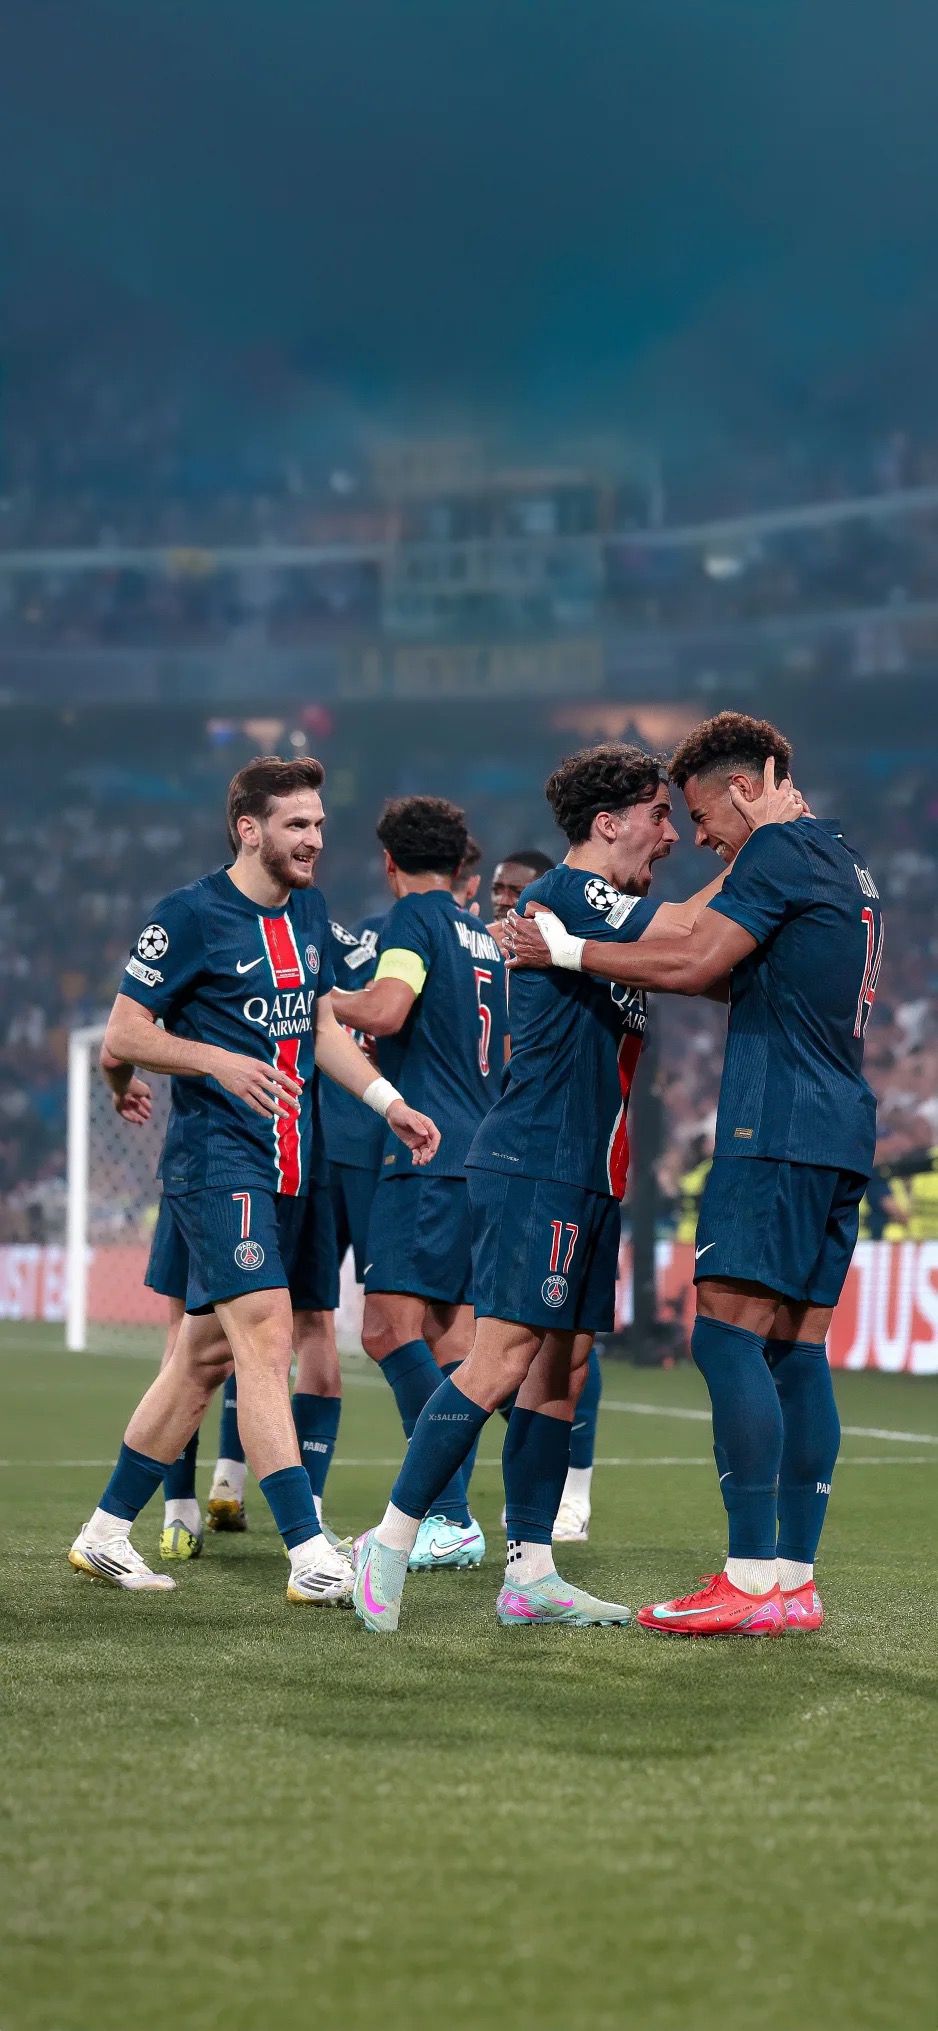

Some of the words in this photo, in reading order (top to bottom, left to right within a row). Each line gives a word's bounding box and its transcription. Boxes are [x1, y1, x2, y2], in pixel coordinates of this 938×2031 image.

[268, 1016, 313, 1038] AIRWAY
[473, 966, 493, 1077] 5
[232, 1192, 251, 1239] 7
[550, 1220, 579, 1273] 17
[303, 1441, 328, 1453] PARIS
